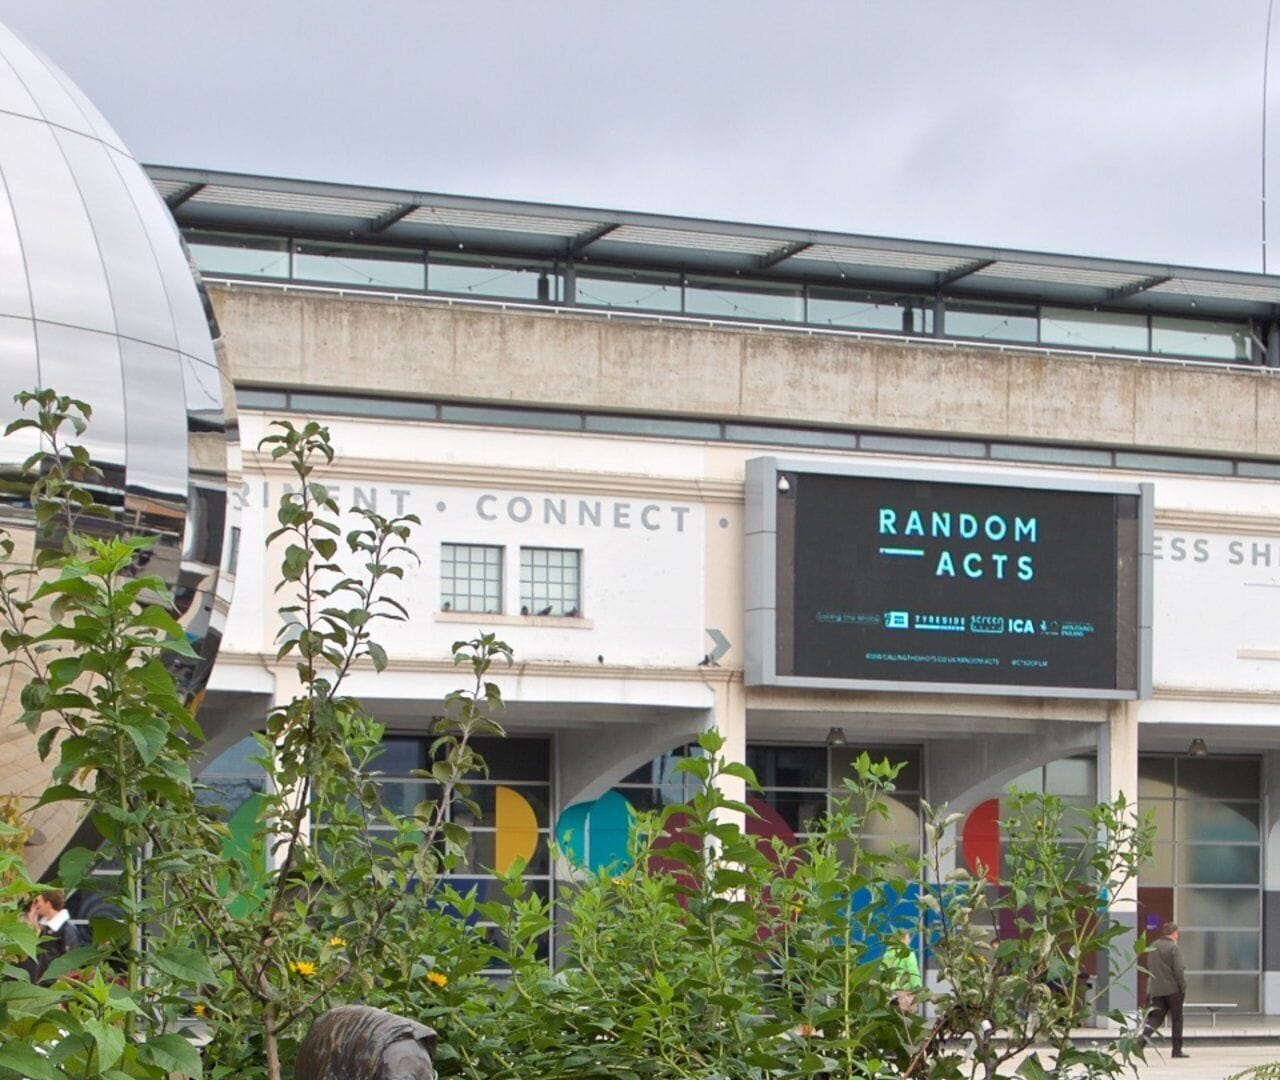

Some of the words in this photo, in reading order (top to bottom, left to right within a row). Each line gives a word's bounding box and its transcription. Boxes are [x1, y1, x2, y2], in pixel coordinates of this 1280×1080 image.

[476, 494, 690, 532] CONNECT
[879, 508, 1037, 543] RANDOM
[936, 551, 1033, 581] ACTS
[1008, 619, 1035, 634] ICA
